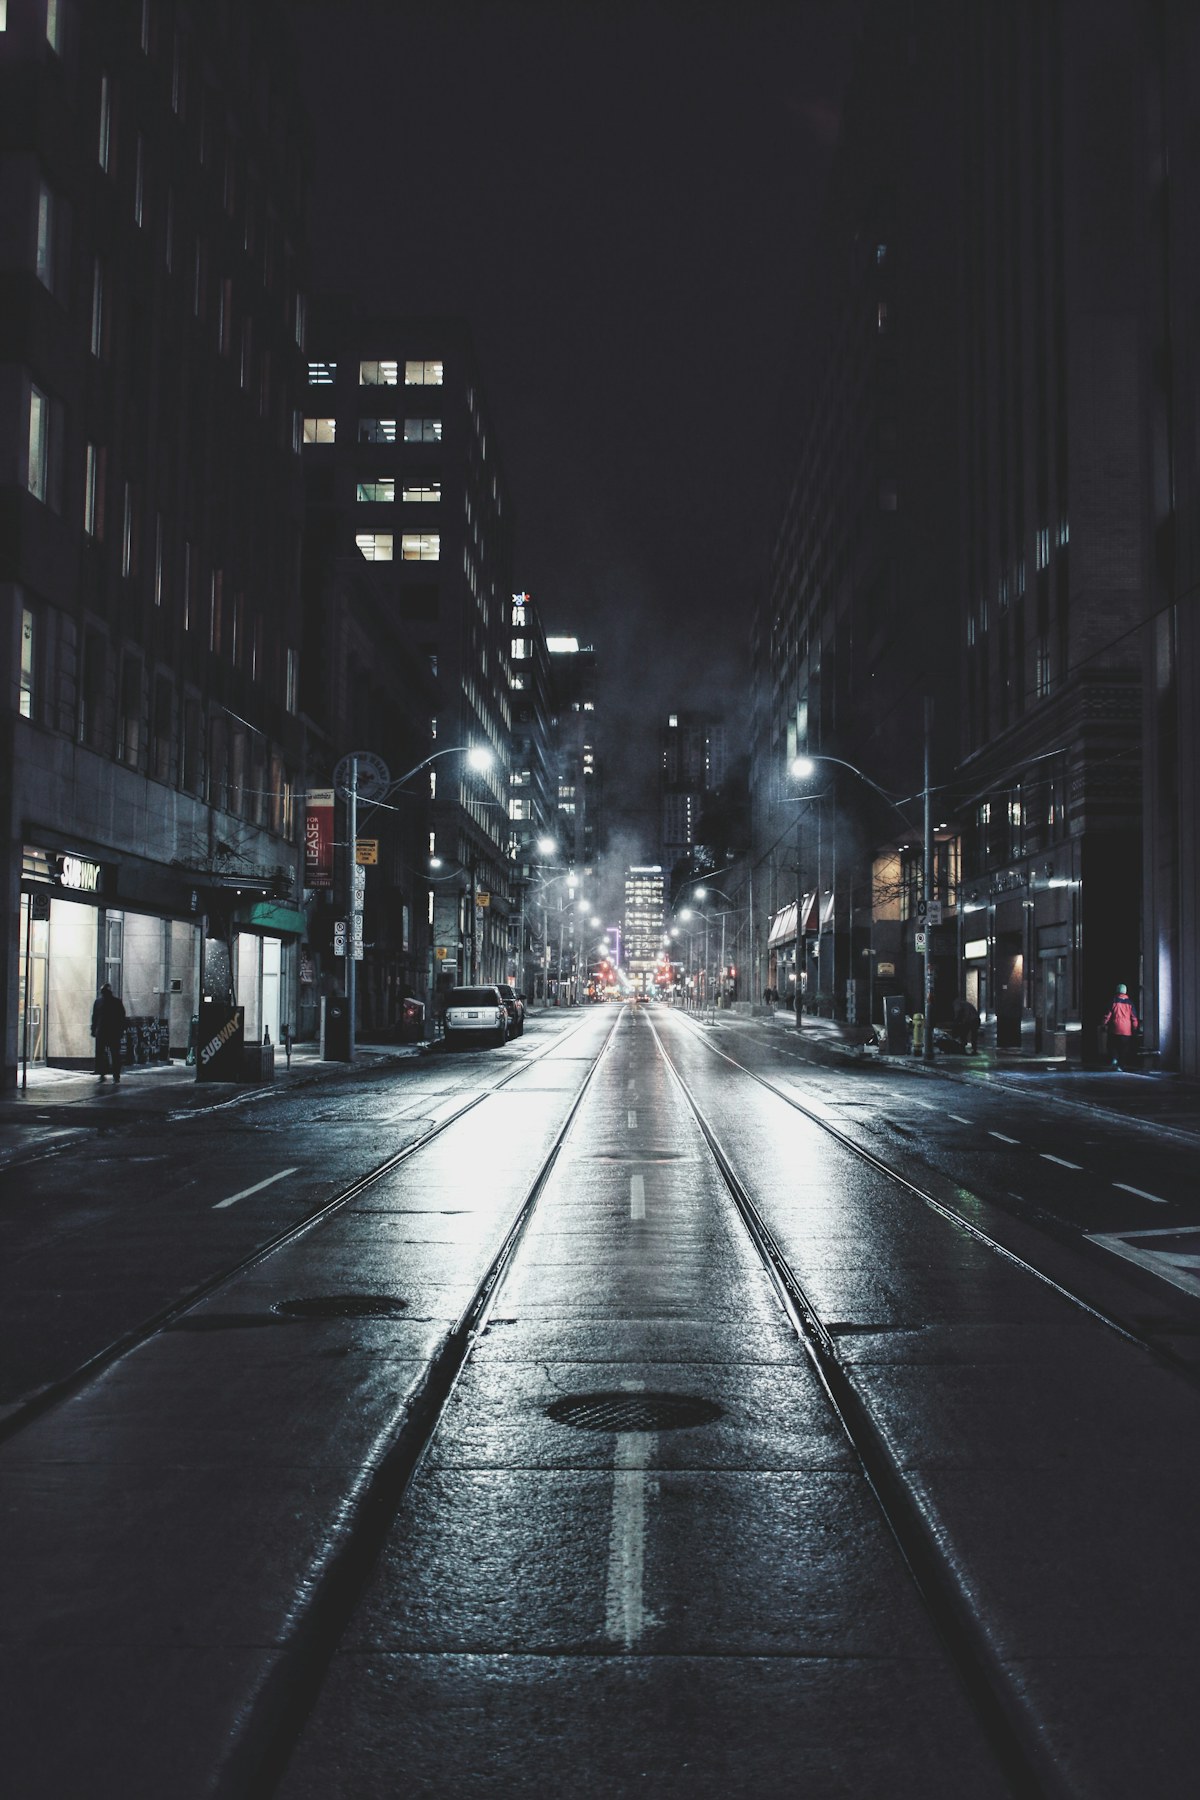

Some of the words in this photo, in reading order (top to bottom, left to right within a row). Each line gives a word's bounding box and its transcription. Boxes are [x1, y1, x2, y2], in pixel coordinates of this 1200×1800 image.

[306, 823, 319, 867] LEASE
[60, 856, 101, 891] SUBWAY
[200, 1012, 241, 1065] SUBWAY
